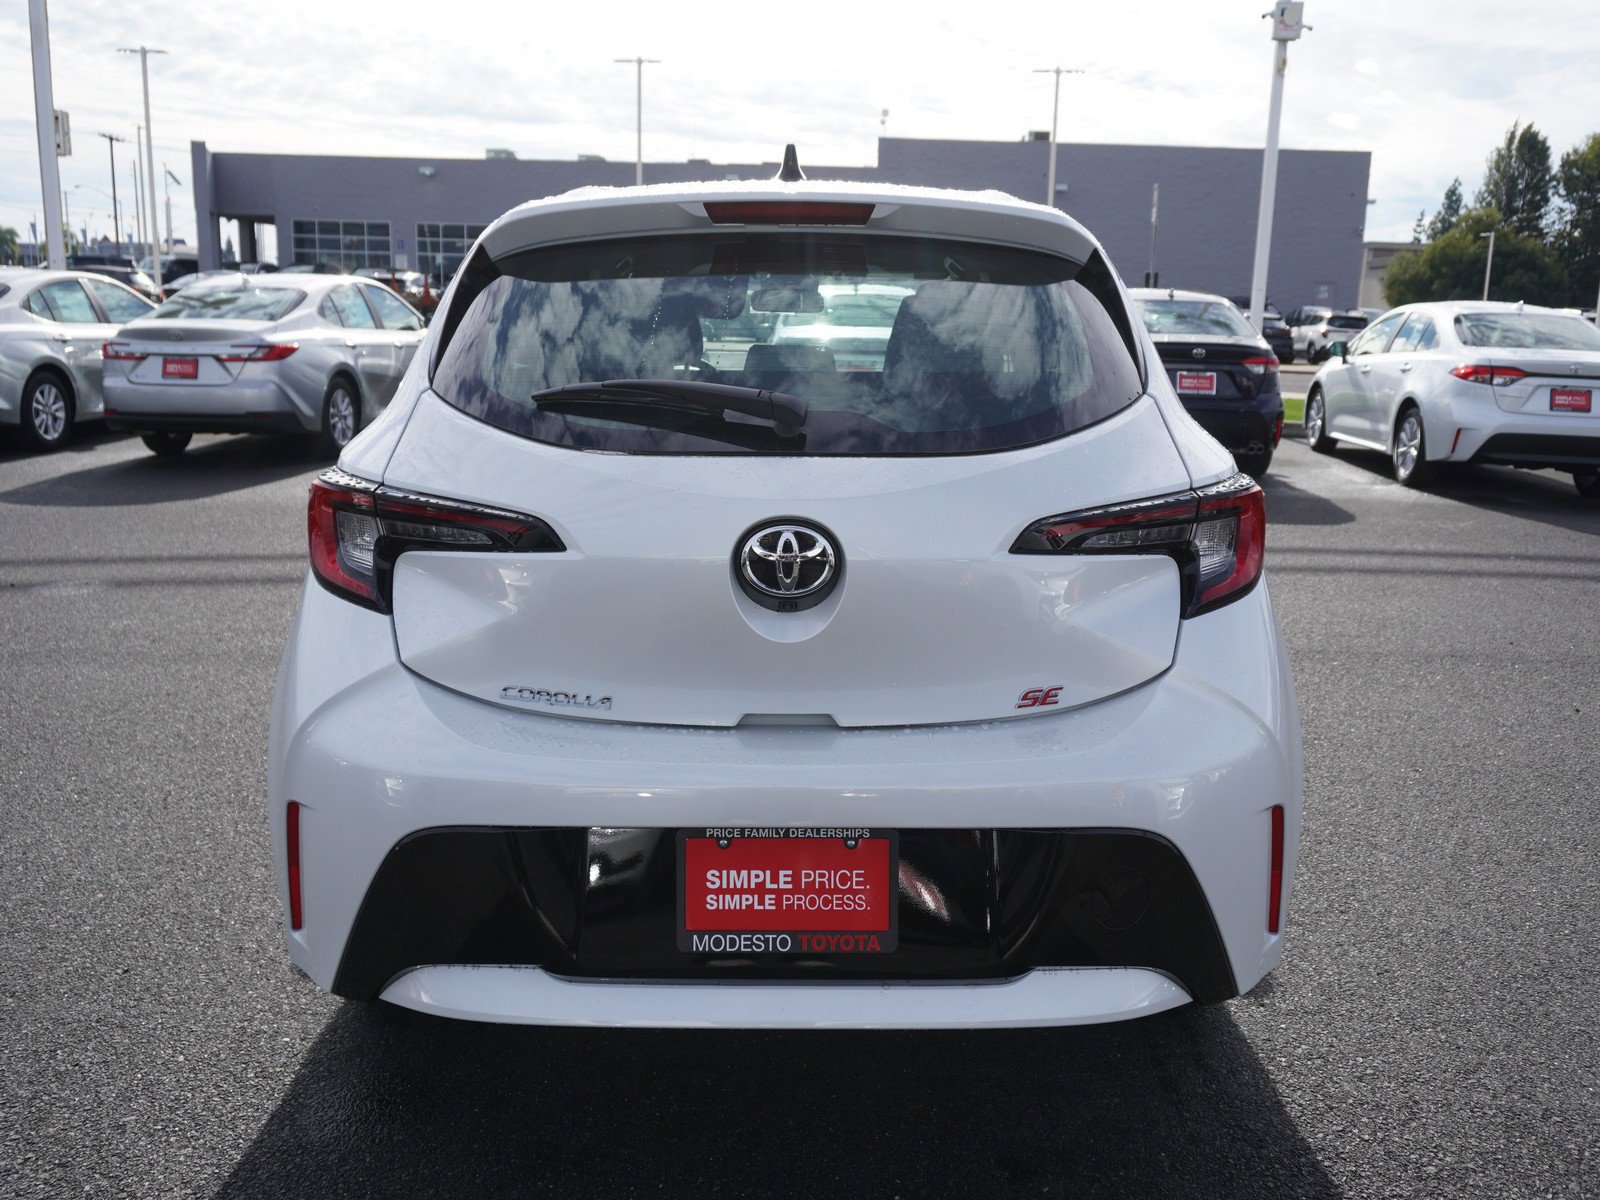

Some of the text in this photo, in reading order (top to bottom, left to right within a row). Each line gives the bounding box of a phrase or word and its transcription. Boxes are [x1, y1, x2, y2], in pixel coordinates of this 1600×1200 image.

[500, 685, 612, 710] COROLLA
[1015, 686, 1064, 709] SE
[706, 828, 870, 838] PRICE FAMILY DEALERSHIPS
[706, 869, 870, 889] SIMPLE PRICE.
[706, 894, 871, 910] SIMPLE PROCESS.
[692, 934, 880, 952] MODESTO TOYOTA
